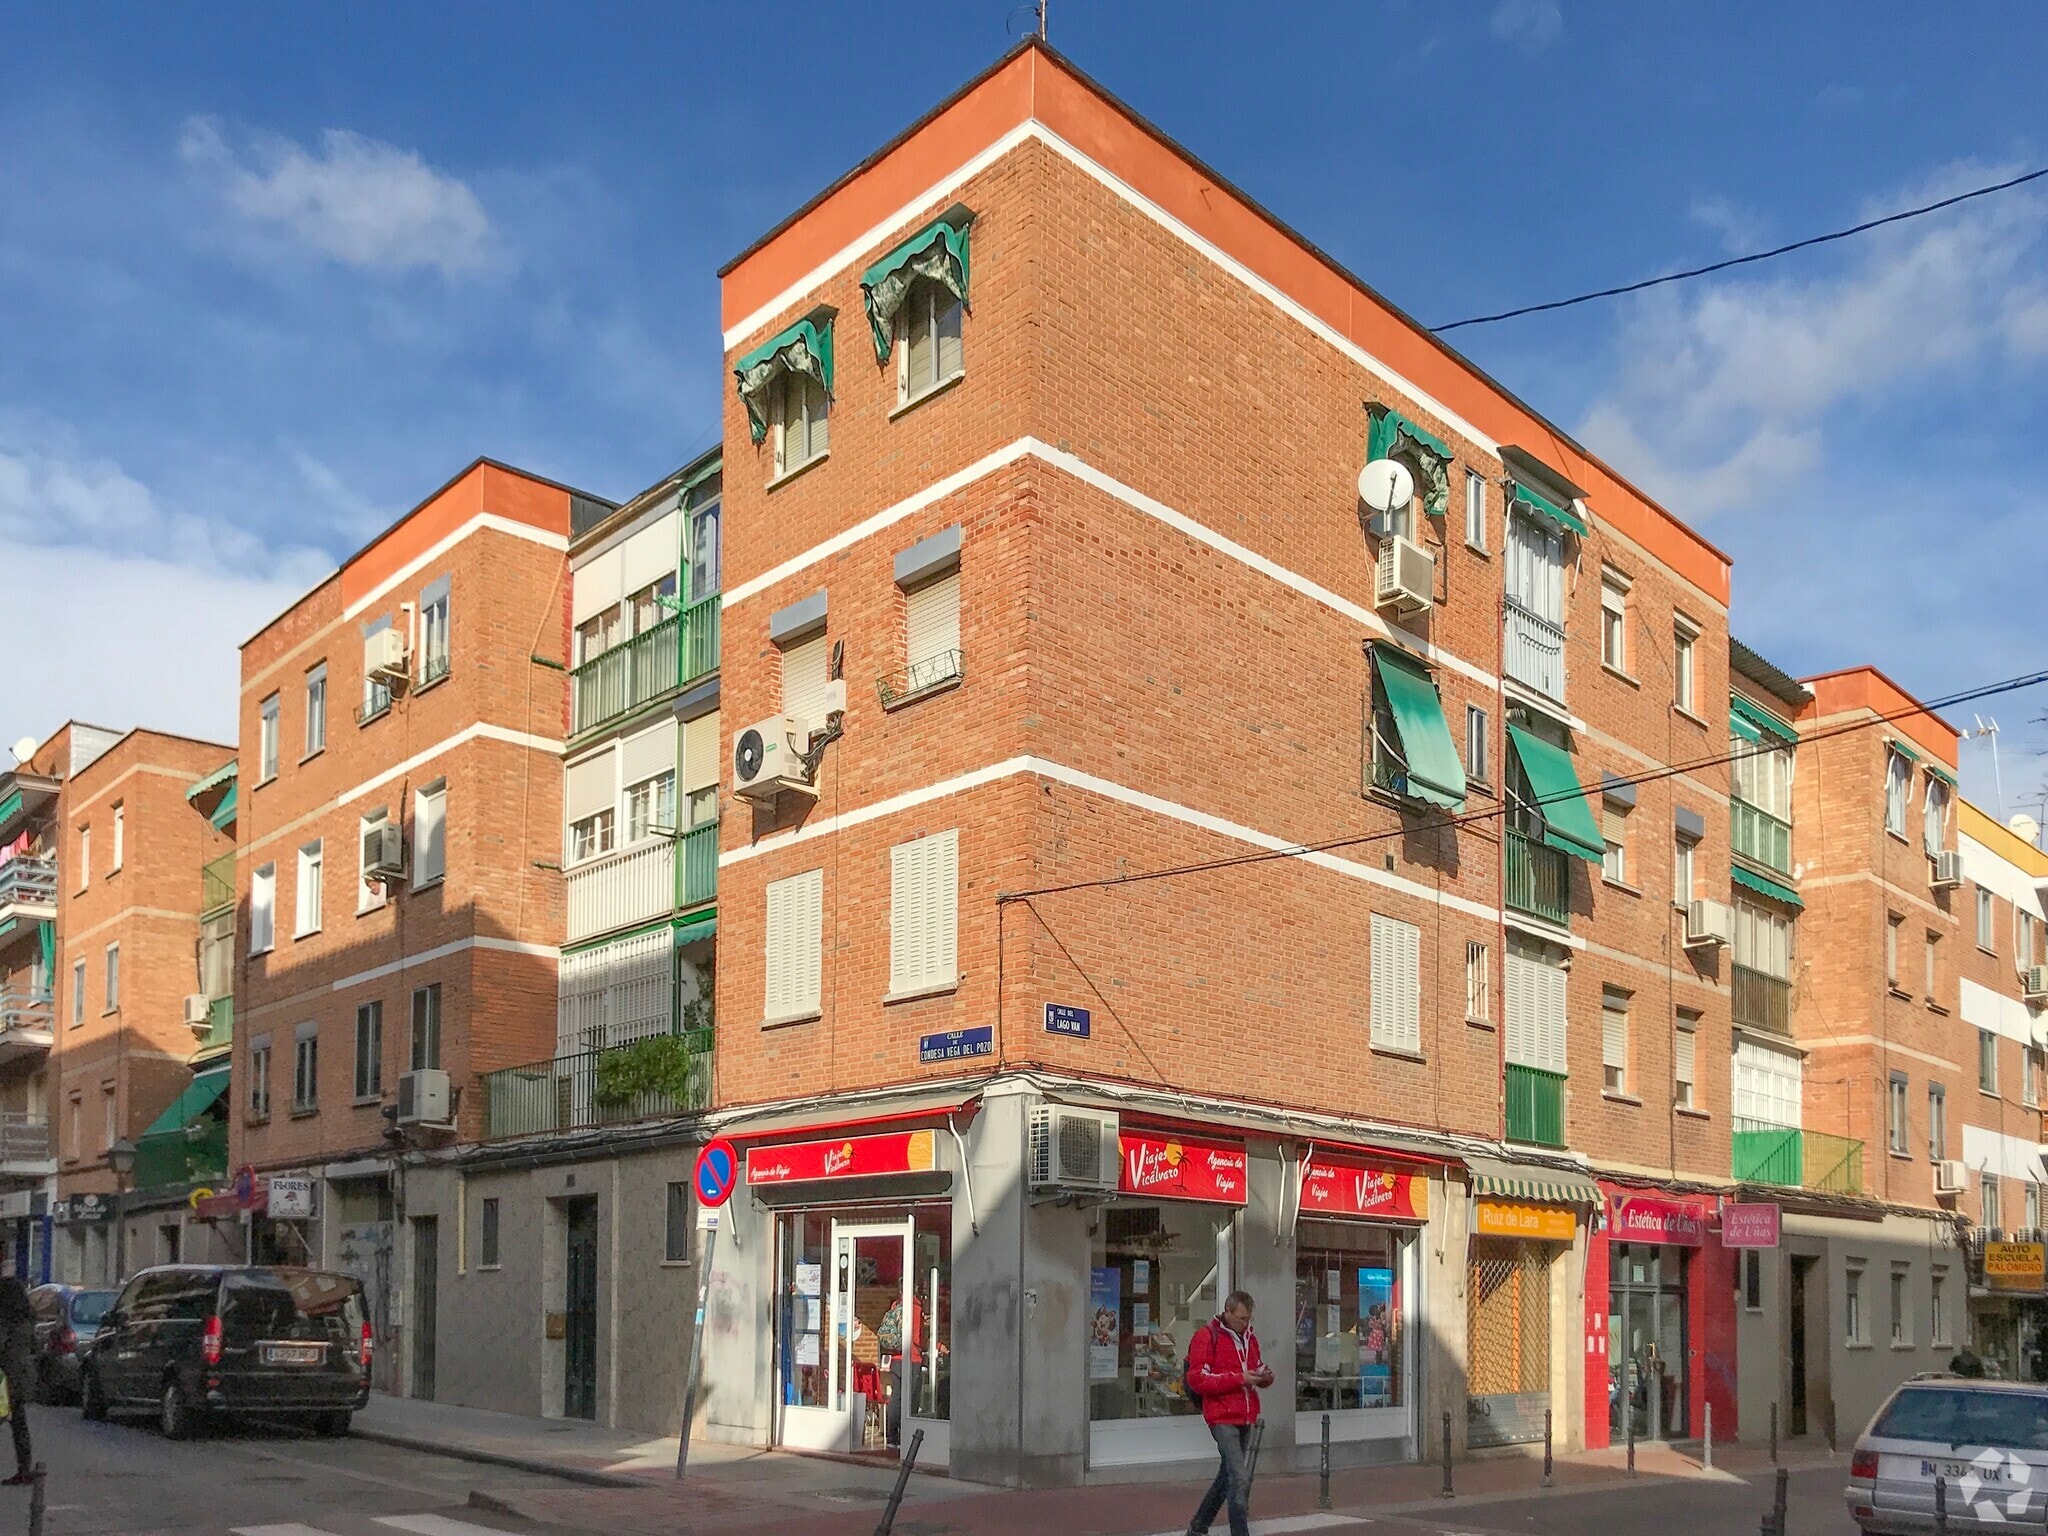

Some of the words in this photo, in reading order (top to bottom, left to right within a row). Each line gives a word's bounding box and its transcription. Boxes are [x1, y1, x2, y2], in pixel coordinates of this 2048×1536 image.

[1057, 1008, 1066, 1016] CALLE
[1057, 1019, 1070, 1030] LAGO
[1070, 1021, 1080, 1032] VAN
[947, 1031, 964, 1040] CALLE
[921, 1048, 944, 1061] CONDESA
[947, 1045, 960, 1057] VEGA
[963, 1043, 974, 1055] DEL
[976, 1041, 992, 1053] POZO
[1207, 1151, 1234, 1170] Agencia
[1233, 1157, 1243, 1168] de
[751, 1167, 769, 1181] Agencia
[776, 1164, 791, 1179] Viajes
[1130, 1156, 1179, 1189] Vicálvaro
[1327, 1168, 1335, 1178] de
[274, 1181, 309, 1191] FLORES
[1215, 1173, 1235, 1193] Viajes
[1311, 1183, 1328, 1202] Viajes
[1355, 1181, 1392, 1210] Vicálvaro
[1483, 1208, 1504, 1225] Ruiz
[1506, 1211, 1517, 1227] de
[1519, 1212, 1539, 1228] Lara
[1628, 1209, 1662, 1230] Estética
[1664, 1213, 1674, 1231] de
[1731, 1213, 1771, 1225] Estética
[1730, 1227, 1741, 1237] de
[1746, 1226, 1771, 1238] Uñas
[1989, 1253, 2041, 1262] ESCUELA
[1988, 1263, 2042, 1272] PALOMERO
[1929, 1463, 1937, 1475] M
[1983, 1468, 2000, 1481] UX
